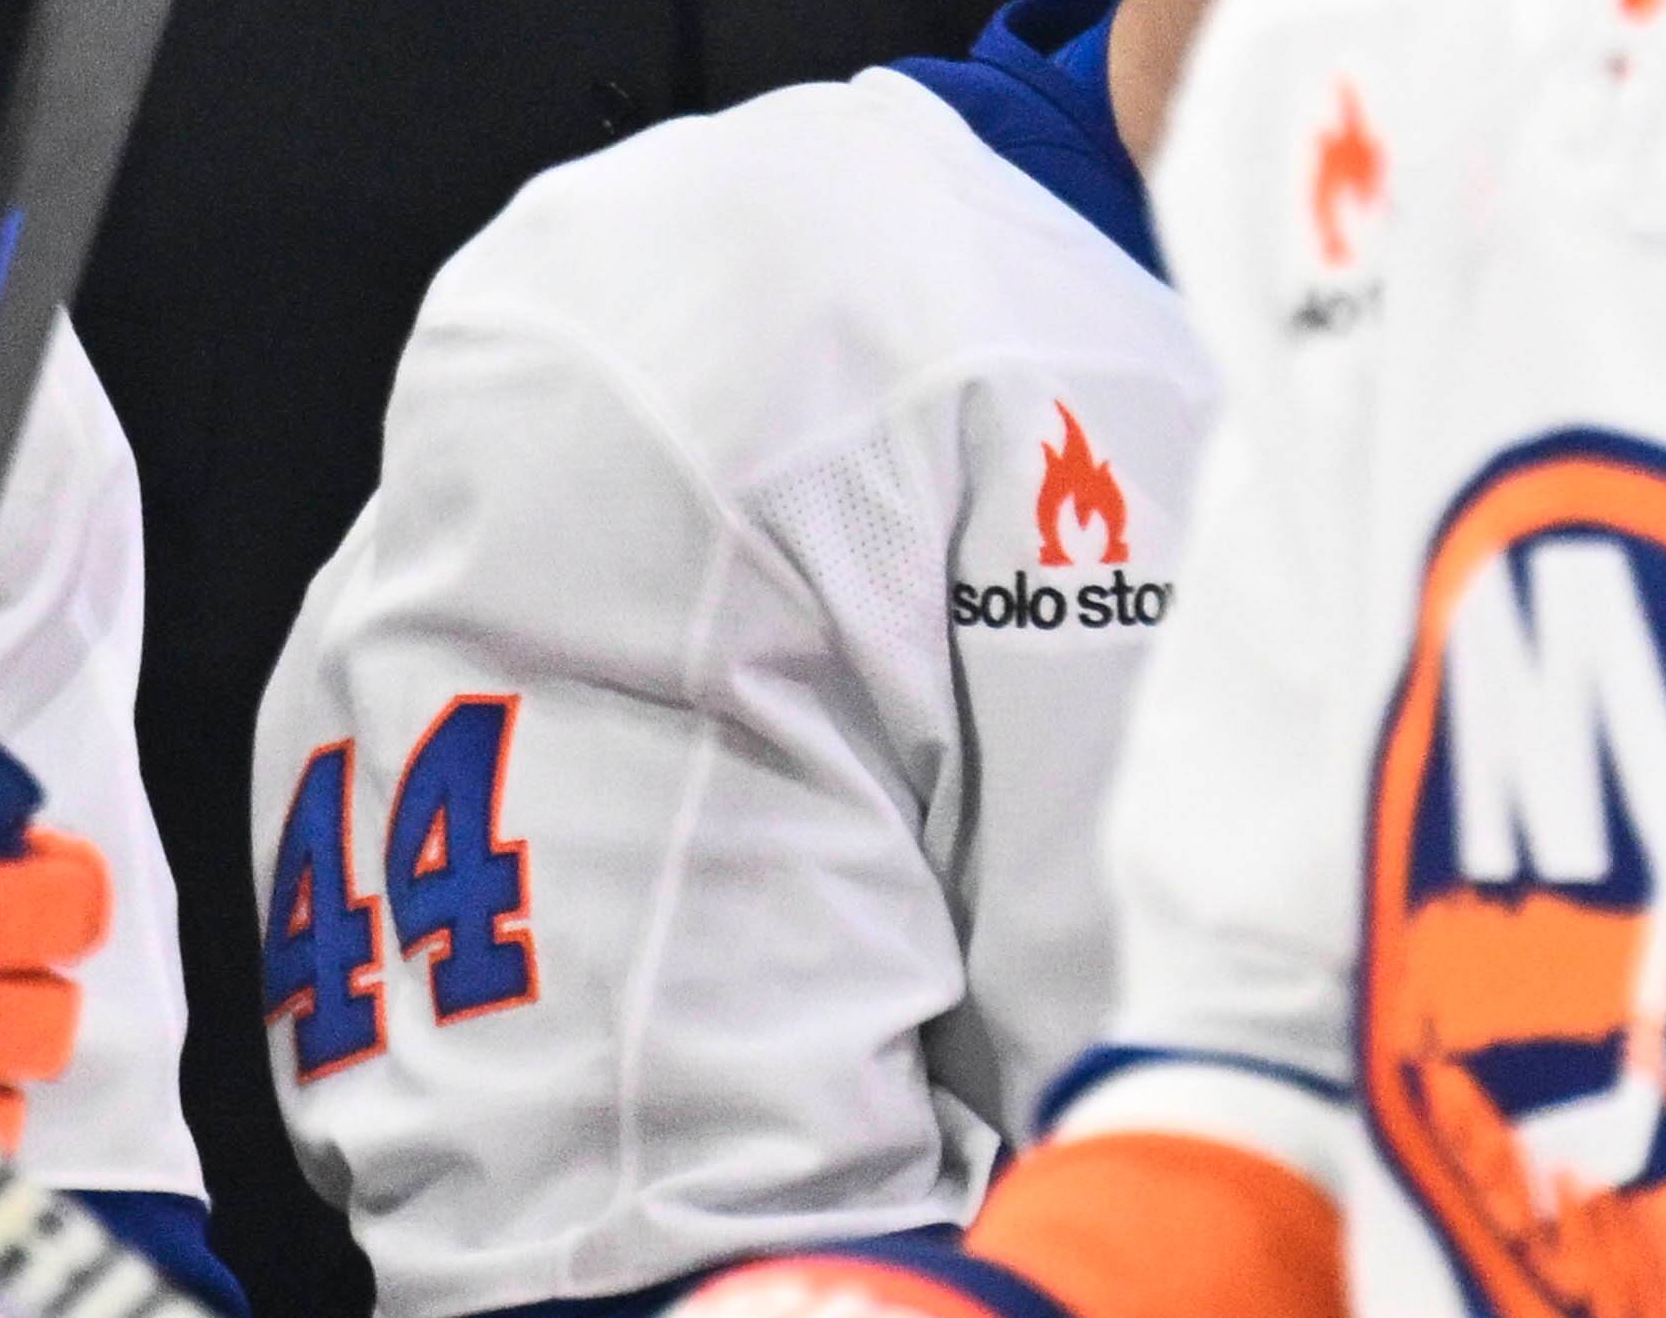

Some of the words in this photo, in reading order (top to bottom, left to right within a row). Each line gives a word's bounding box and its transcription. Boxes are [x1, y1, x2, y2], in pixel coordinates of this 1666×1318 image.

[951, 569, 1067, 630] solo
[1077, 568, 1175, 628] sto
[261, 691, 539, 1087] 44
